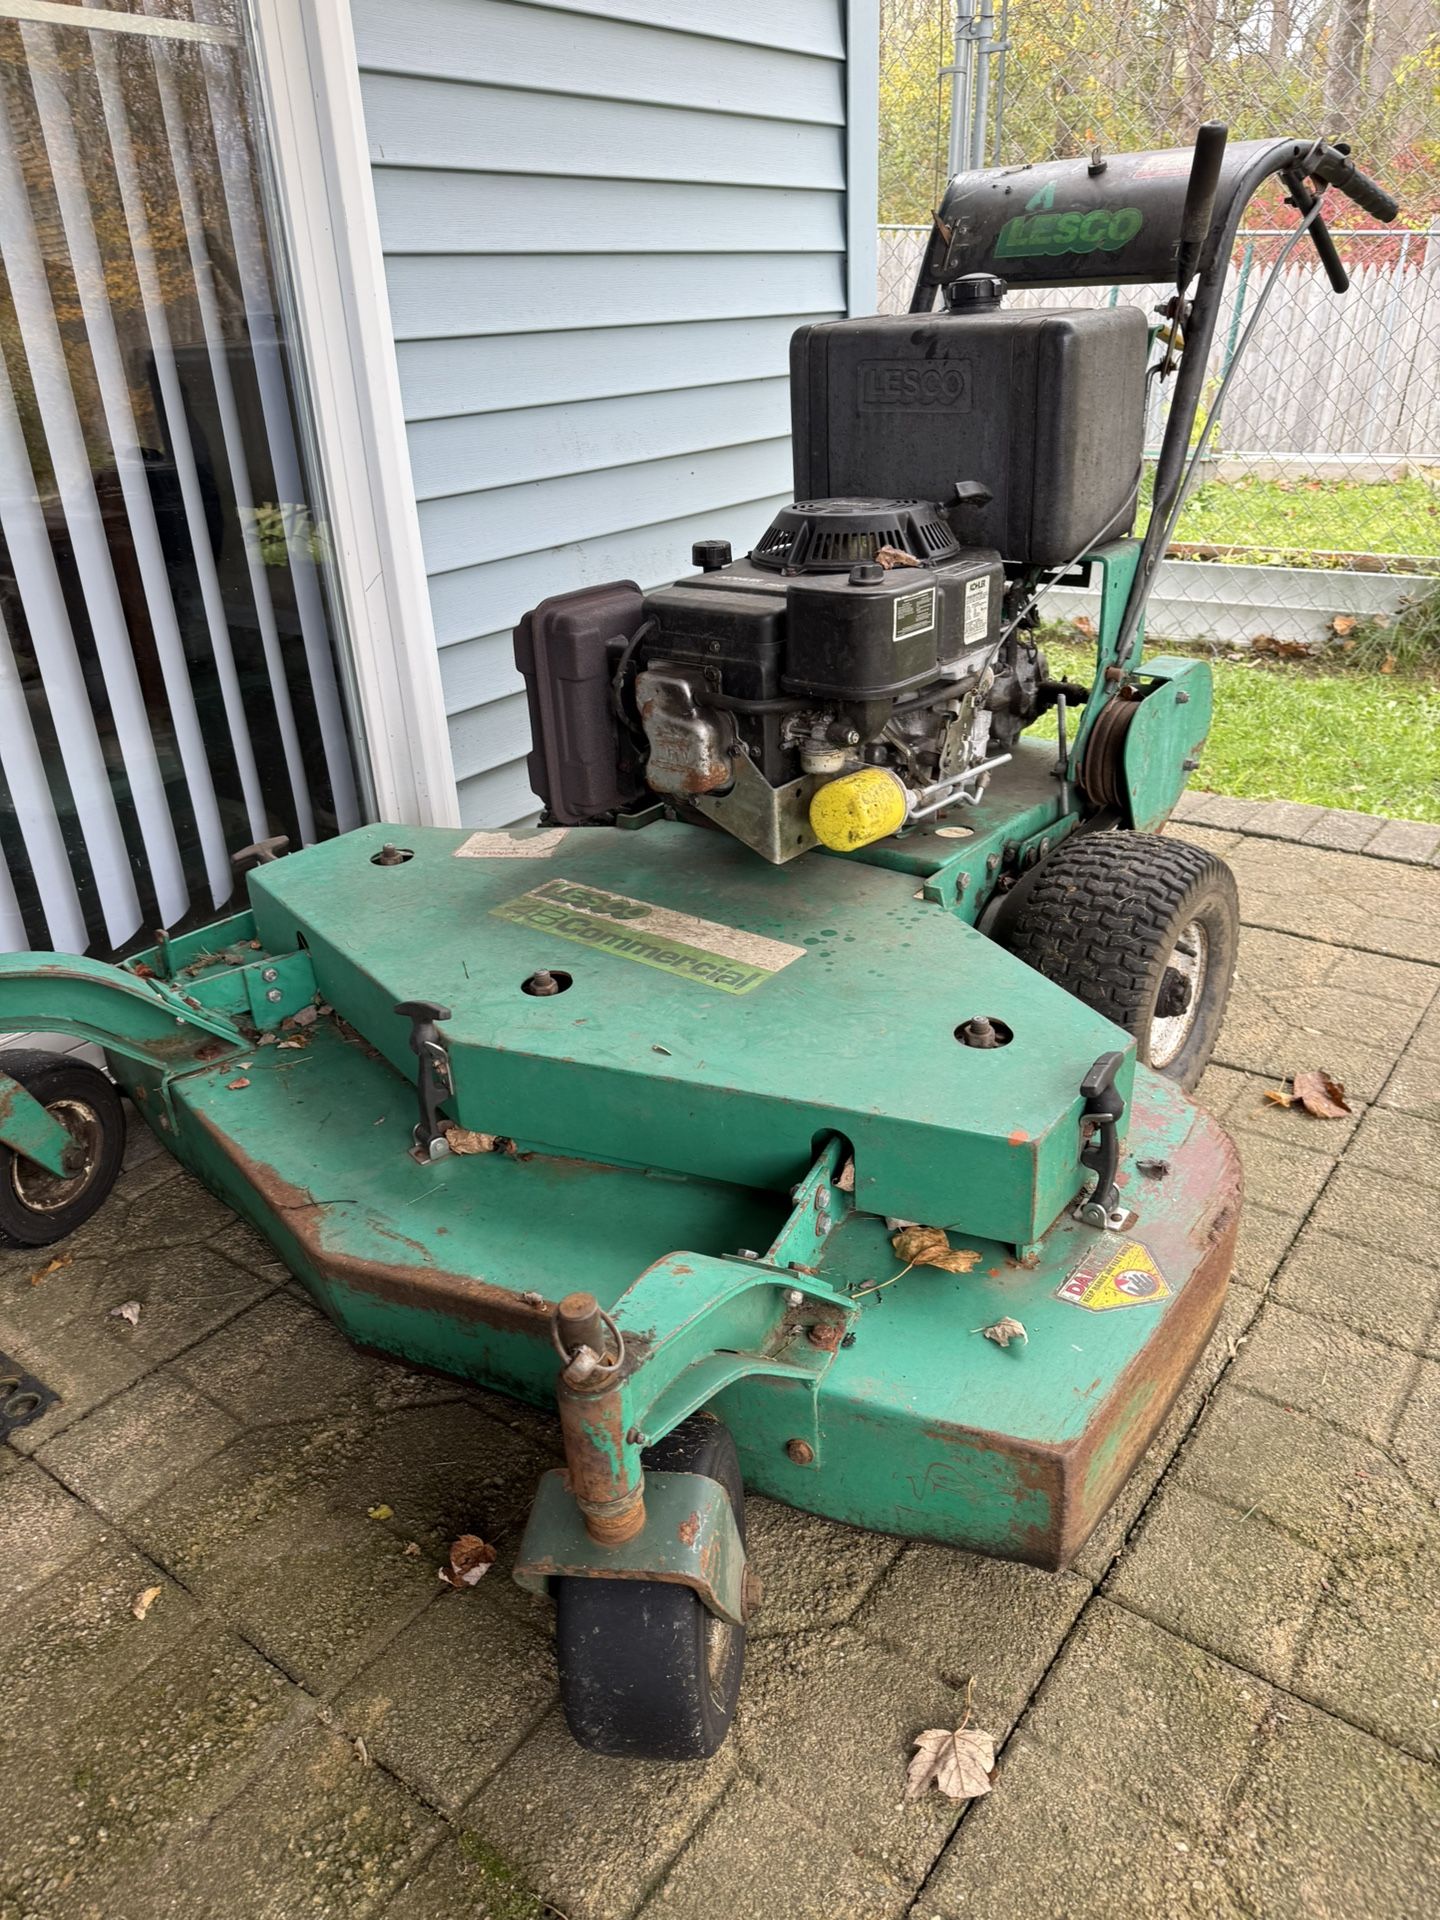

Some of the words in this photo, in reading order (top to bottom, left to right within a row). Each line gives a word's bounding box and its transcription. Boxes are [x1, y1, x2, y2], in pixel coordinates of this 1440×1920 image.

[998, 208, 1142, 255] LESCO
[864, 368, 964, 405] LESCO
[534, 883, 653, 919] LESCO
[1082, 1289, 1096, 1303] KEEP
